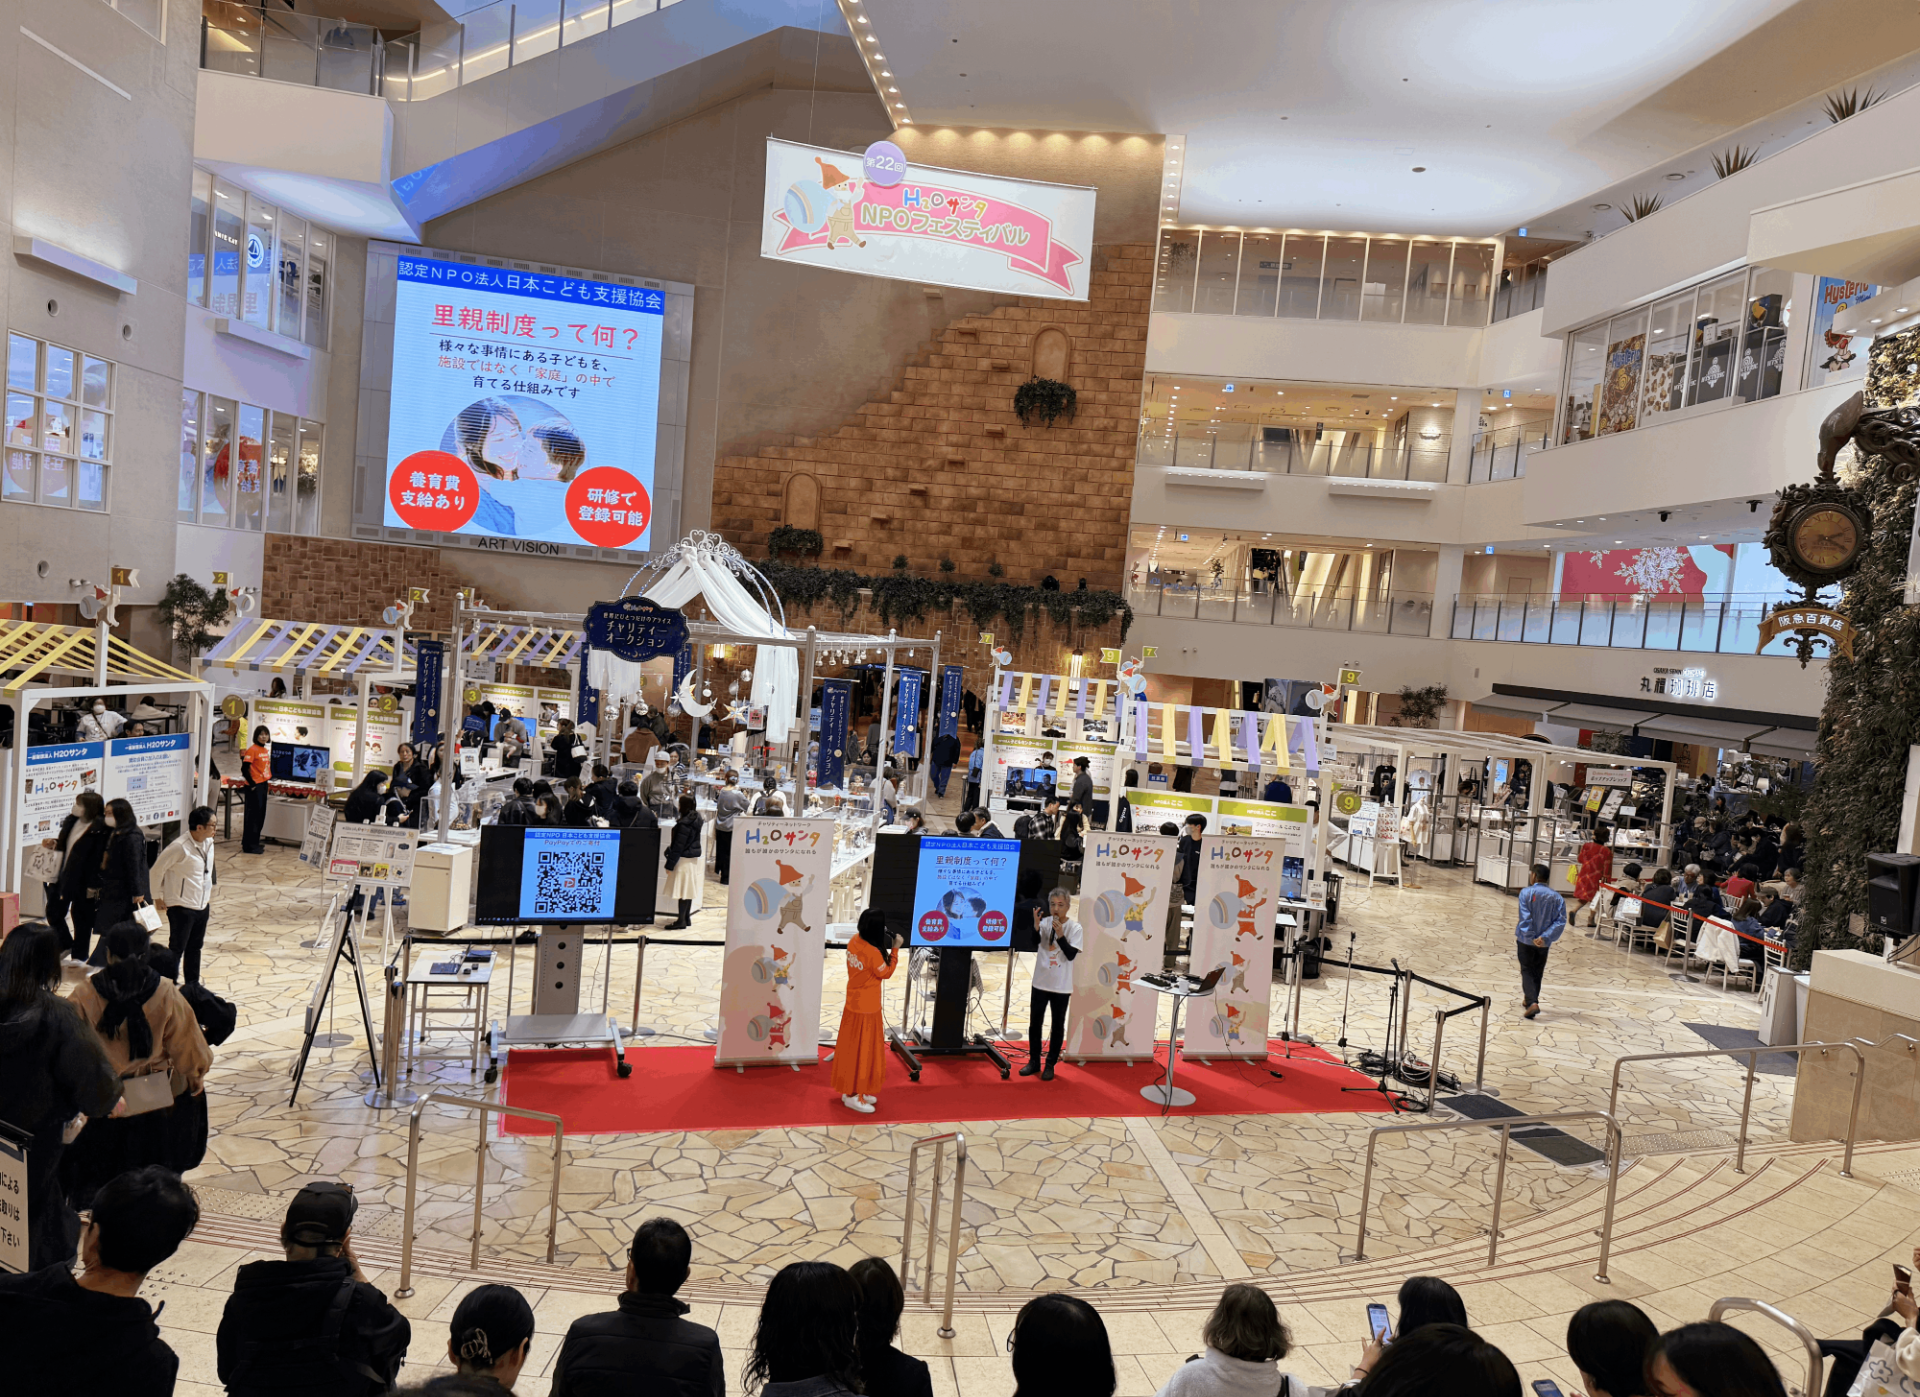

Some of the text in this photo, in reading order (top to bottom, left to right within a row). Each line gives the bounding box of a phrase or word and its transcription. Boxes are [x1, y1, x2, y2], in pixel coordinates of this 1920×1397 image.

[866, 154, 904, 173] 第22回
[862, 203, 1030, 246] NPOフェスティバル
[398, 260, 662, 310] 認定NPO法人日本こども支援協会
[431, 303, 639, 351] 里親制度って何？
[439, 339, 609, 372] 様々な事情にある子どもを、
[437, 354, 616, 388] 施設ではなく「家庭」の中で
[473, 375, 580, 399] 育てる仕組みです
[409, 471, 460, 492] 養育費
[400, 490, 466, 511] 支給あり
[587, 488, 637, 507] 研修で
[578, 505, 643, 527] 登録可能
[477, 536, 559, 555] ART VISION
[117, 570, 124, 584] 1
[218, 573, 225, 583] 2
[413, 590, 421, 600] 2
[606, 620, 667, 636] チャリティー
[1778, 613, 1845, 631] 阪急百貨店
[606, 632, 665, 648] オークション
[984, 634, 991, 644] 7
[1107, 650, 1115, 662] 9
[1146, 648, 1153, 656] 7
[1347, 672, 1355, 683] 9
[469, 690, 477, 701] 3
[1640, 676, 1715, 699] 丸福珈琲店
[228, 700, 236, 715] 1
[383, 698, 392, 710] 2
[53, 748, 88, 759] H2Oサンタ
[35, 780, 78, 795] H2Oサンタ
[1344, 796, 1355, 810] 9
[745, 828, 821, 847] H2Oサンタ
[1096, 843, 1164, 863] H2Oサンタ
[1211, 845, 1273, 864] H2Oサンタ
[1, 1226, 21, 1248] 下さい
